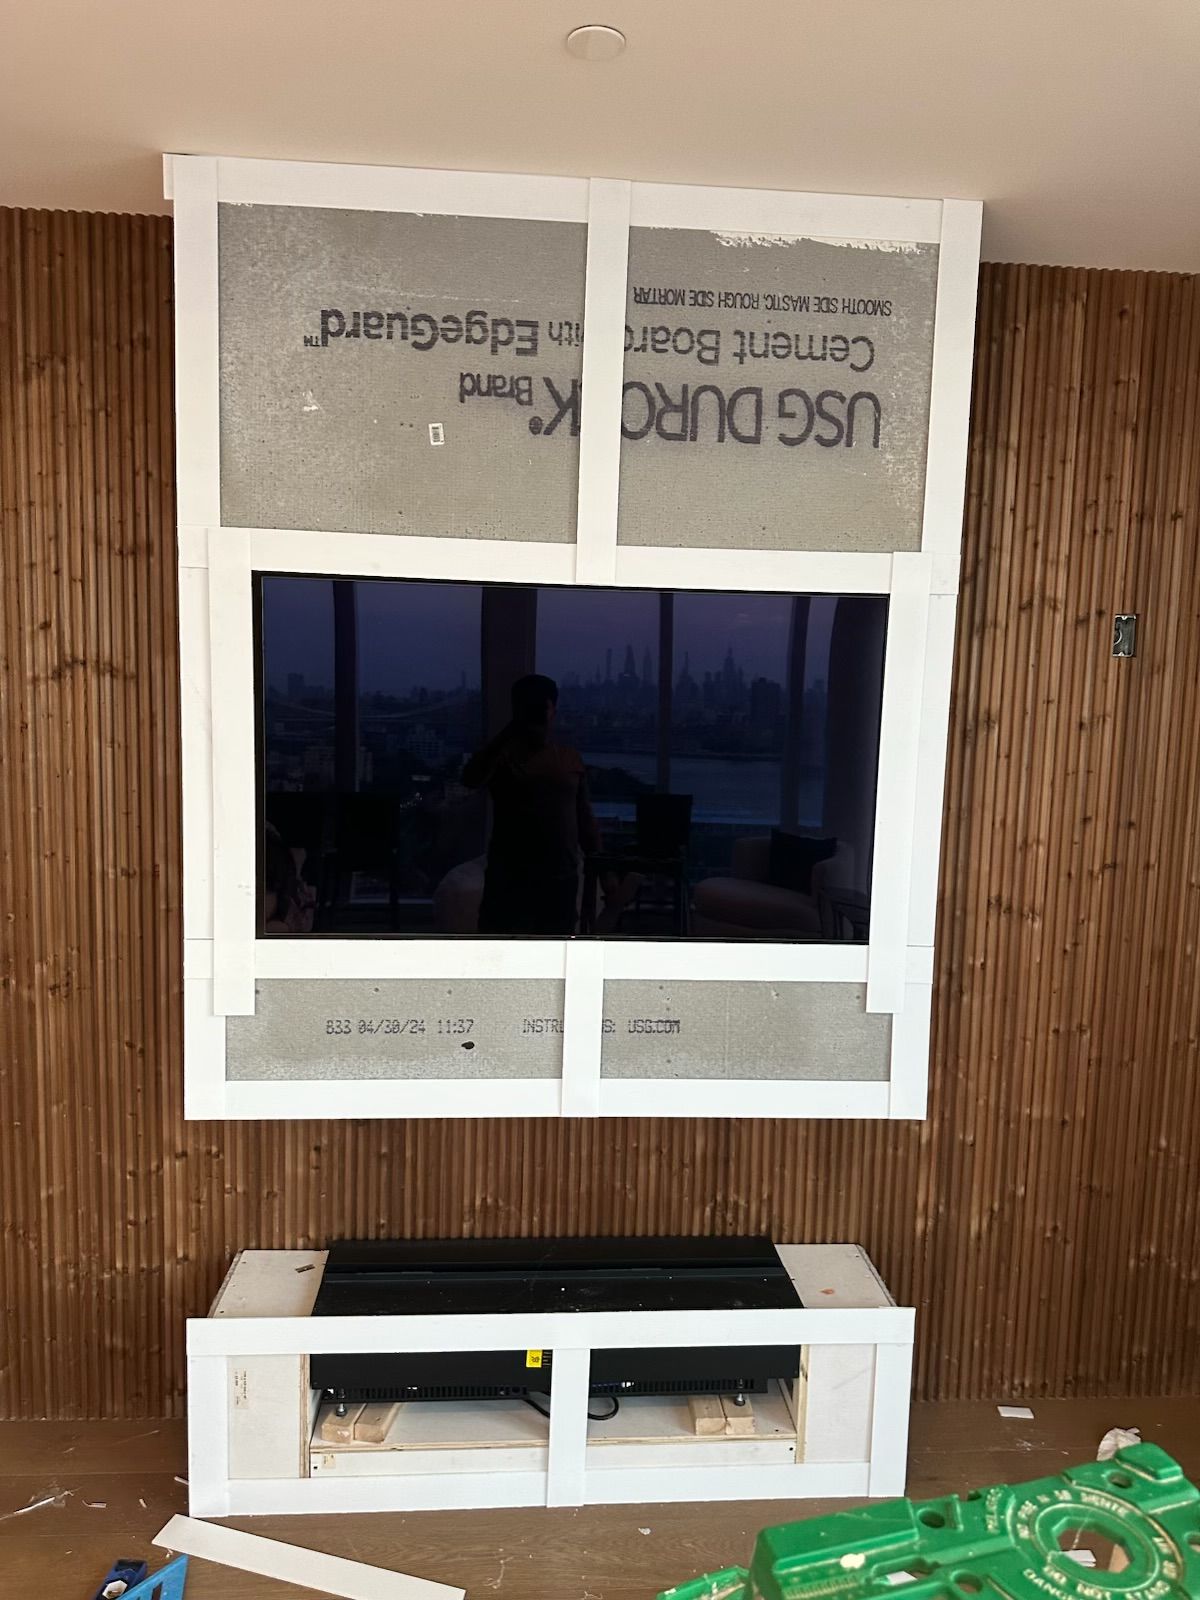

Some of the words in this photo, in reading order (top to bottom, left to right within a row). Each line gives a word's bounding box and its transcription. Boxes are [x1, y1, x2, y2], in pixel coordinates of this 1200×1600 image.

[633, 287, 685, 306] MORTAR
[688, 289, 714, 307] SIDE
[718, 291, 760, 309] ROUGH
[813, 296, 839, 313] SIDE
[842, 298, 892, 316] SMOOTH
[548, 321, 584, 346] ith
[733, 329, 875, 372] Cement
[460, 371, 533, 406] Brand
[777, 388, 882, 448] USG
[358, 1019, 427, 1035] 04/30/24
[437, 1018, 475, 1034] 11:37
